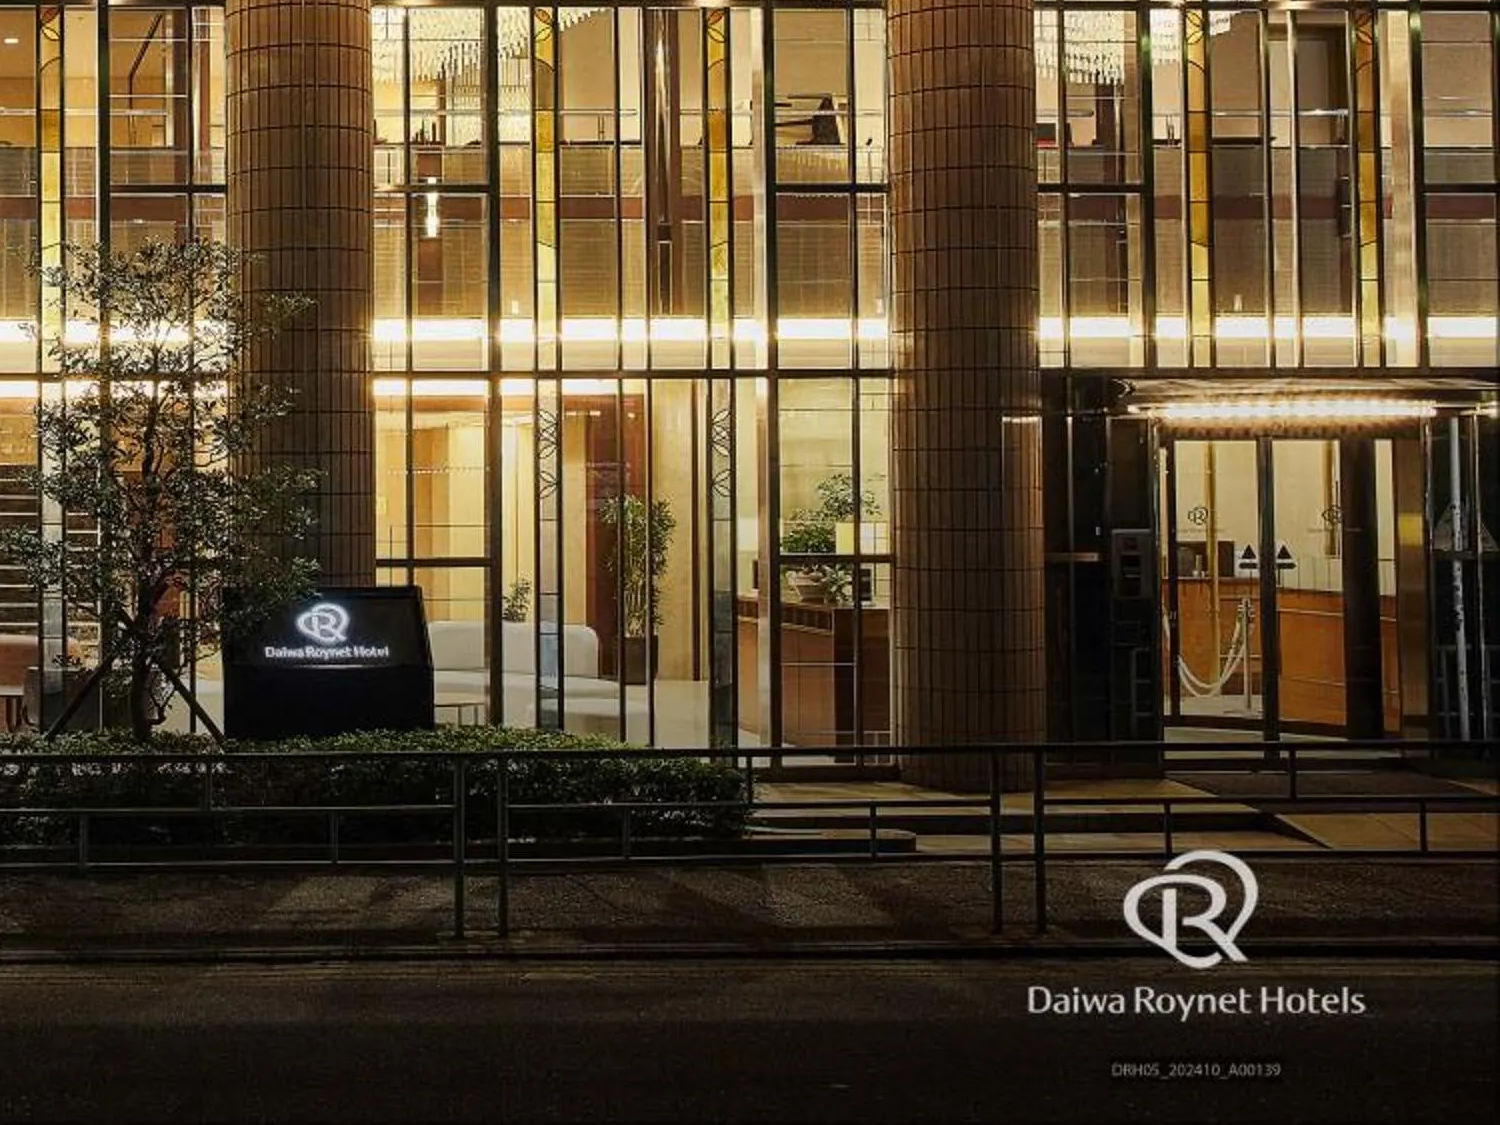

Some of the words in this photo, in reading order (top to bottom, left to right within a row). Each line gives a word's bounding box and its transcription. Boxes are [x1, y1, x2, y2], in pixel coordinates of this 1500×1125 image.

[264, 646, 304, 658] Daiwa
[305, 645, 352, 660] Roynet
[353, 646, 389, 658] Hotel
